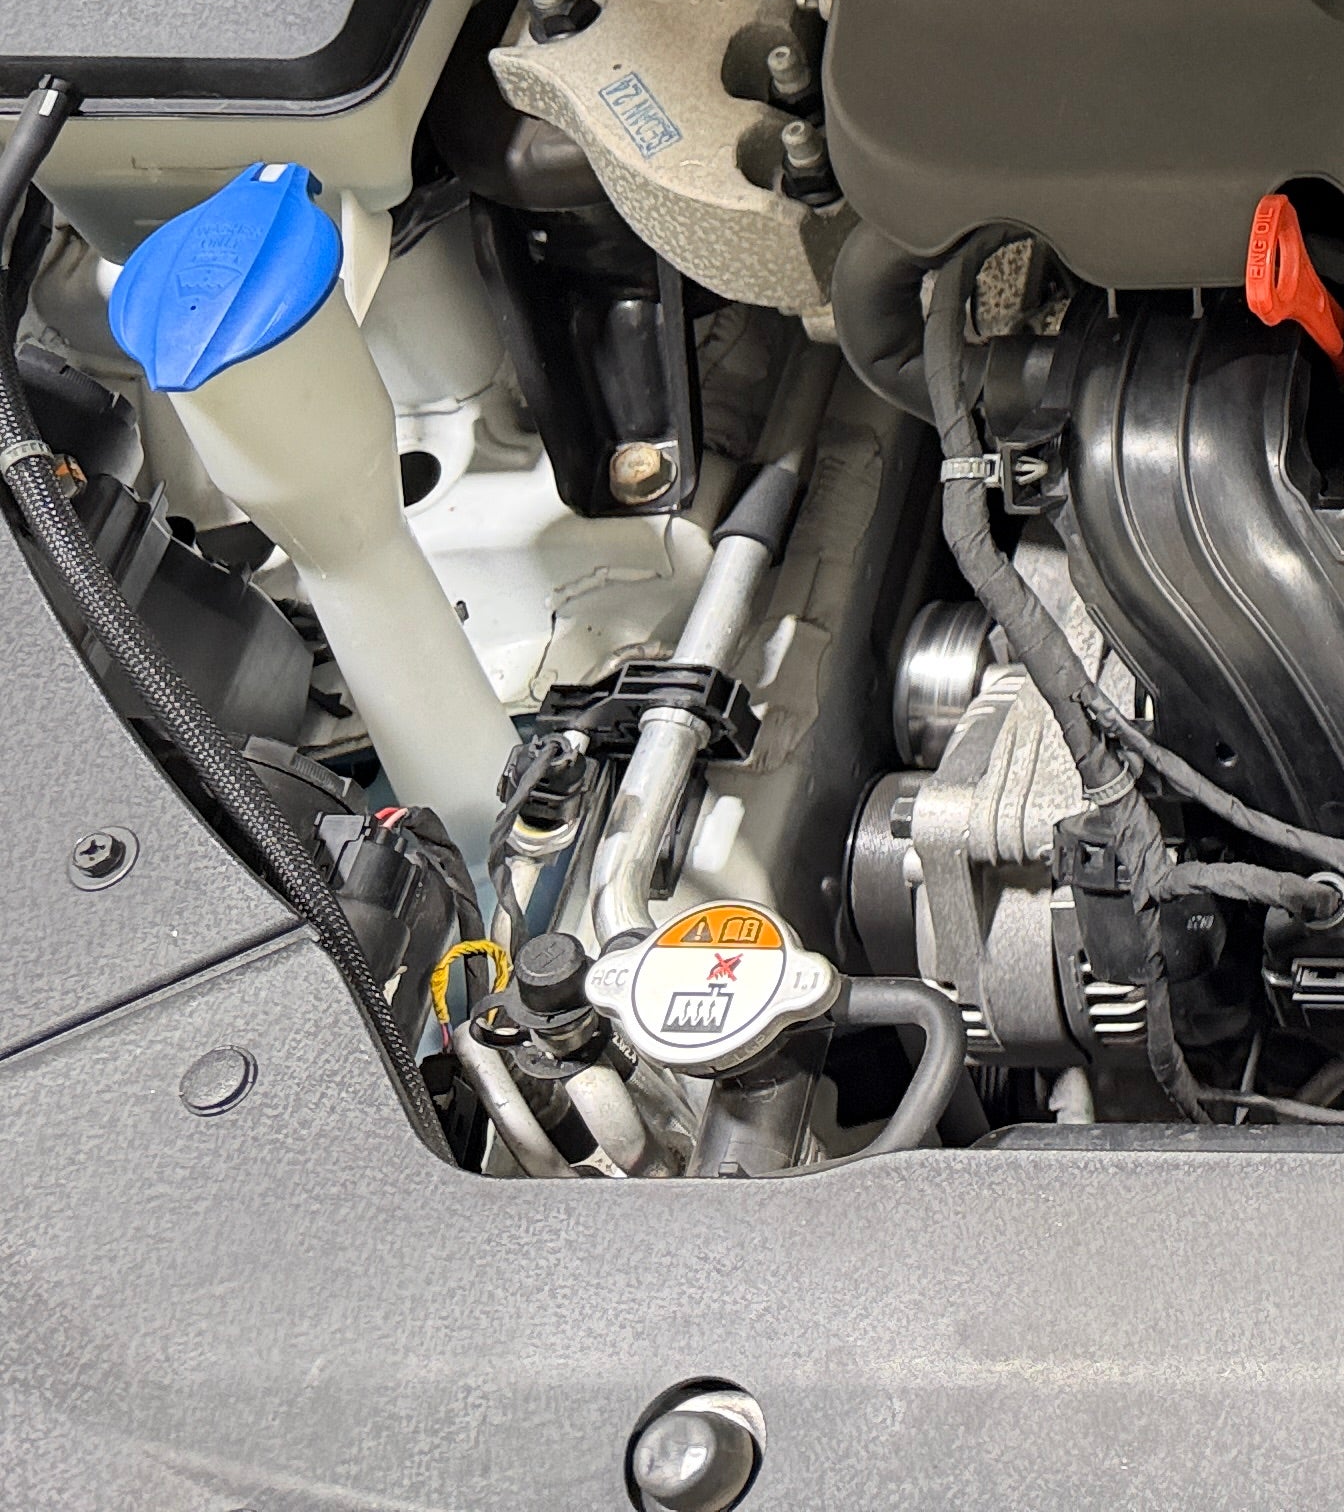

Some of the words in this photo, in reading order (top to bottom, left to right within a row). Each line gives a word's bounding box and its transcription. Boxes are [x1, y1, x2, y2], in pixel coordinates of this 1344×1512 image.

[1254, 207, 1274, 235] OIL
[1250, 239, 1268, 280] ENG
[591, 968, 629, 987] HCC
